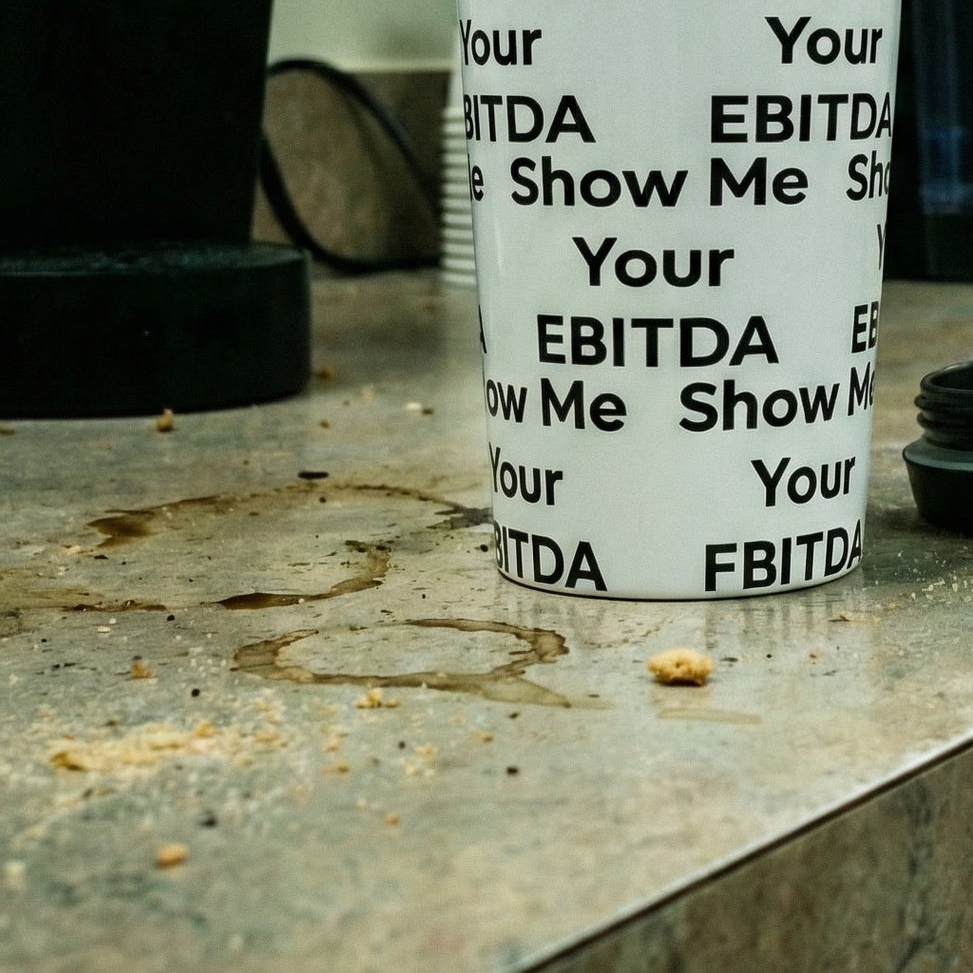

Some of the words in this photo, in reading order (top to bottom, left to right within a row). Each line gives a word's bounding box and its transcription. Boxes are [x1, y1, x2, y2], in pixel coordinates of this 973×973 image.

[460, 19, 542, 66] Your
[765, 17, 882, 64] Your
[711, 92, 891, 143] EBITDA
[511, 156, 688, 207] Show
[710, 158, 808, 206] Me
[572, 237, 734, 287] Your
[537, 315, 779, 367] EBITDA
[485, 379, 528, 422] ow
[541, 378, 626, 431] Me
[680, 380, 839, 432] Show
[488, 441, 563, 505] Your
[751, 457, 855, 506] Your
